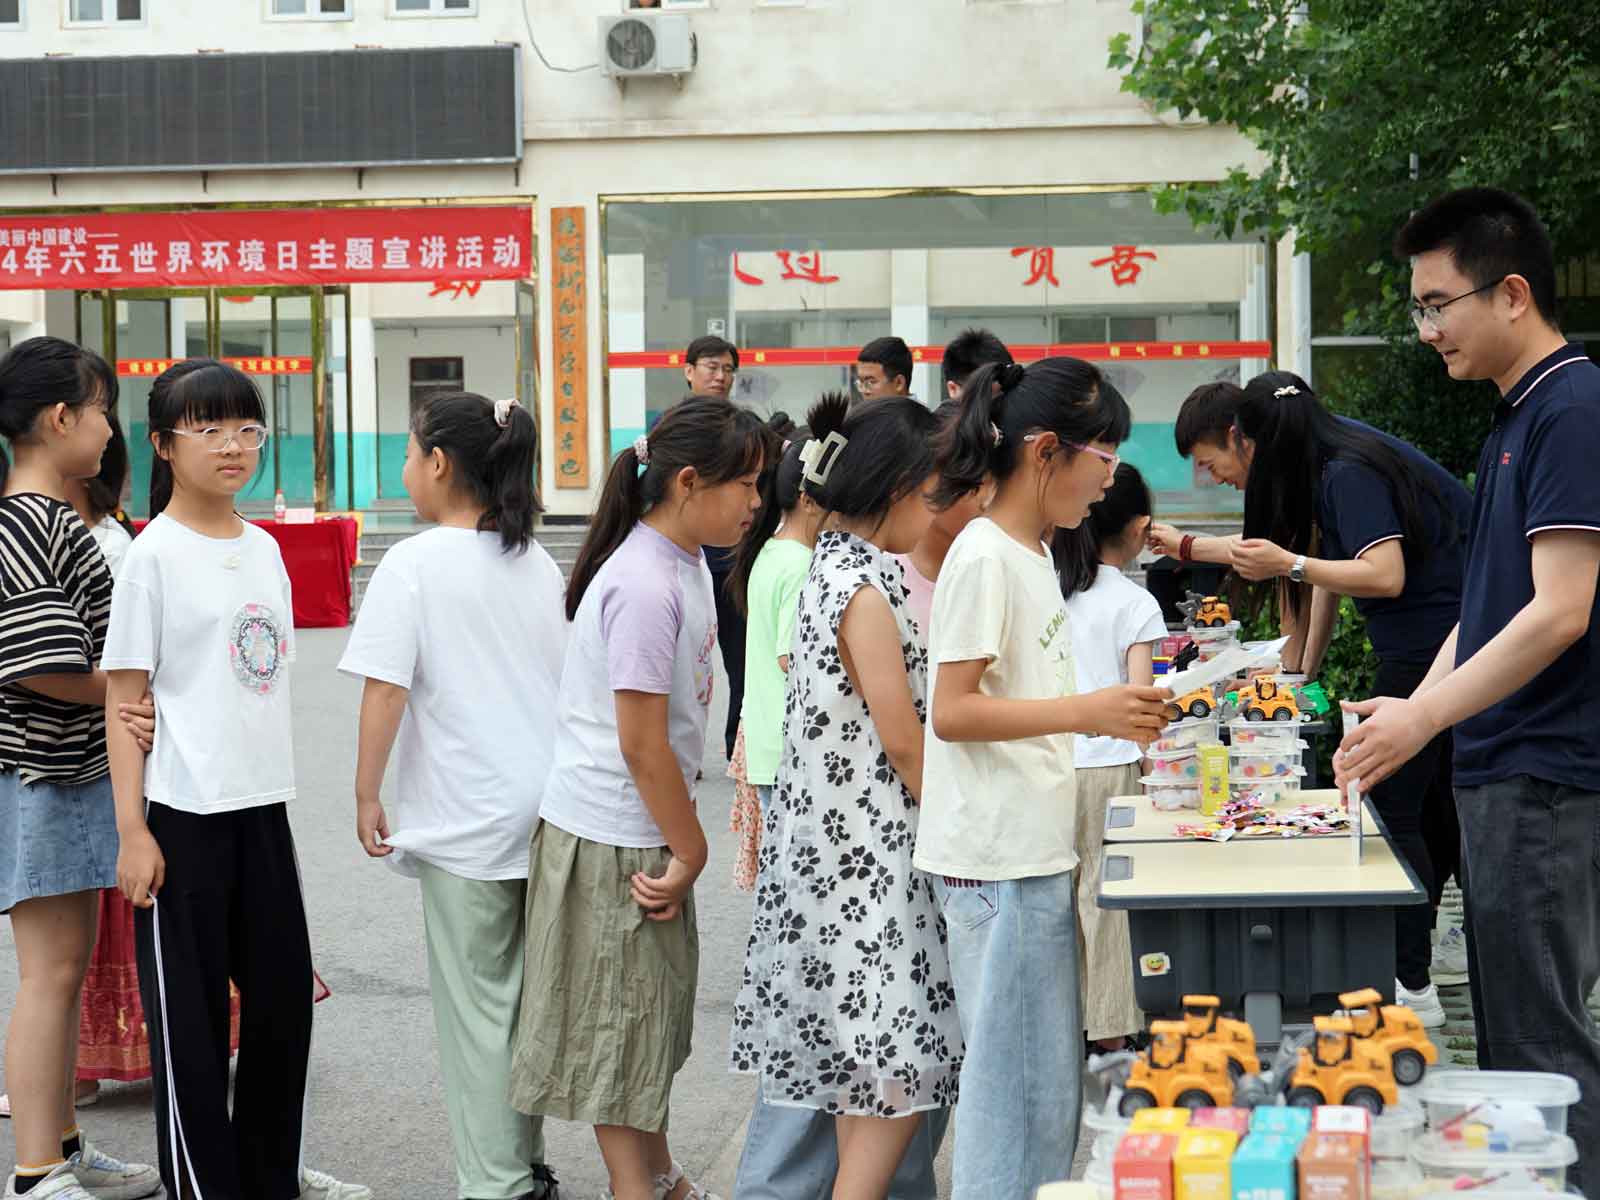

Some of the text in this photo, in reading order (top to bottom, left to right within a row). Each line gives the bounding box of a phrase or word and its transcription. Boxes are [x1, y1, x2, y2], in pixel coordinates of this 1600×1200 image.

[1, 235, 522, 277] 4年六五世界环境日主题宣讲活动
